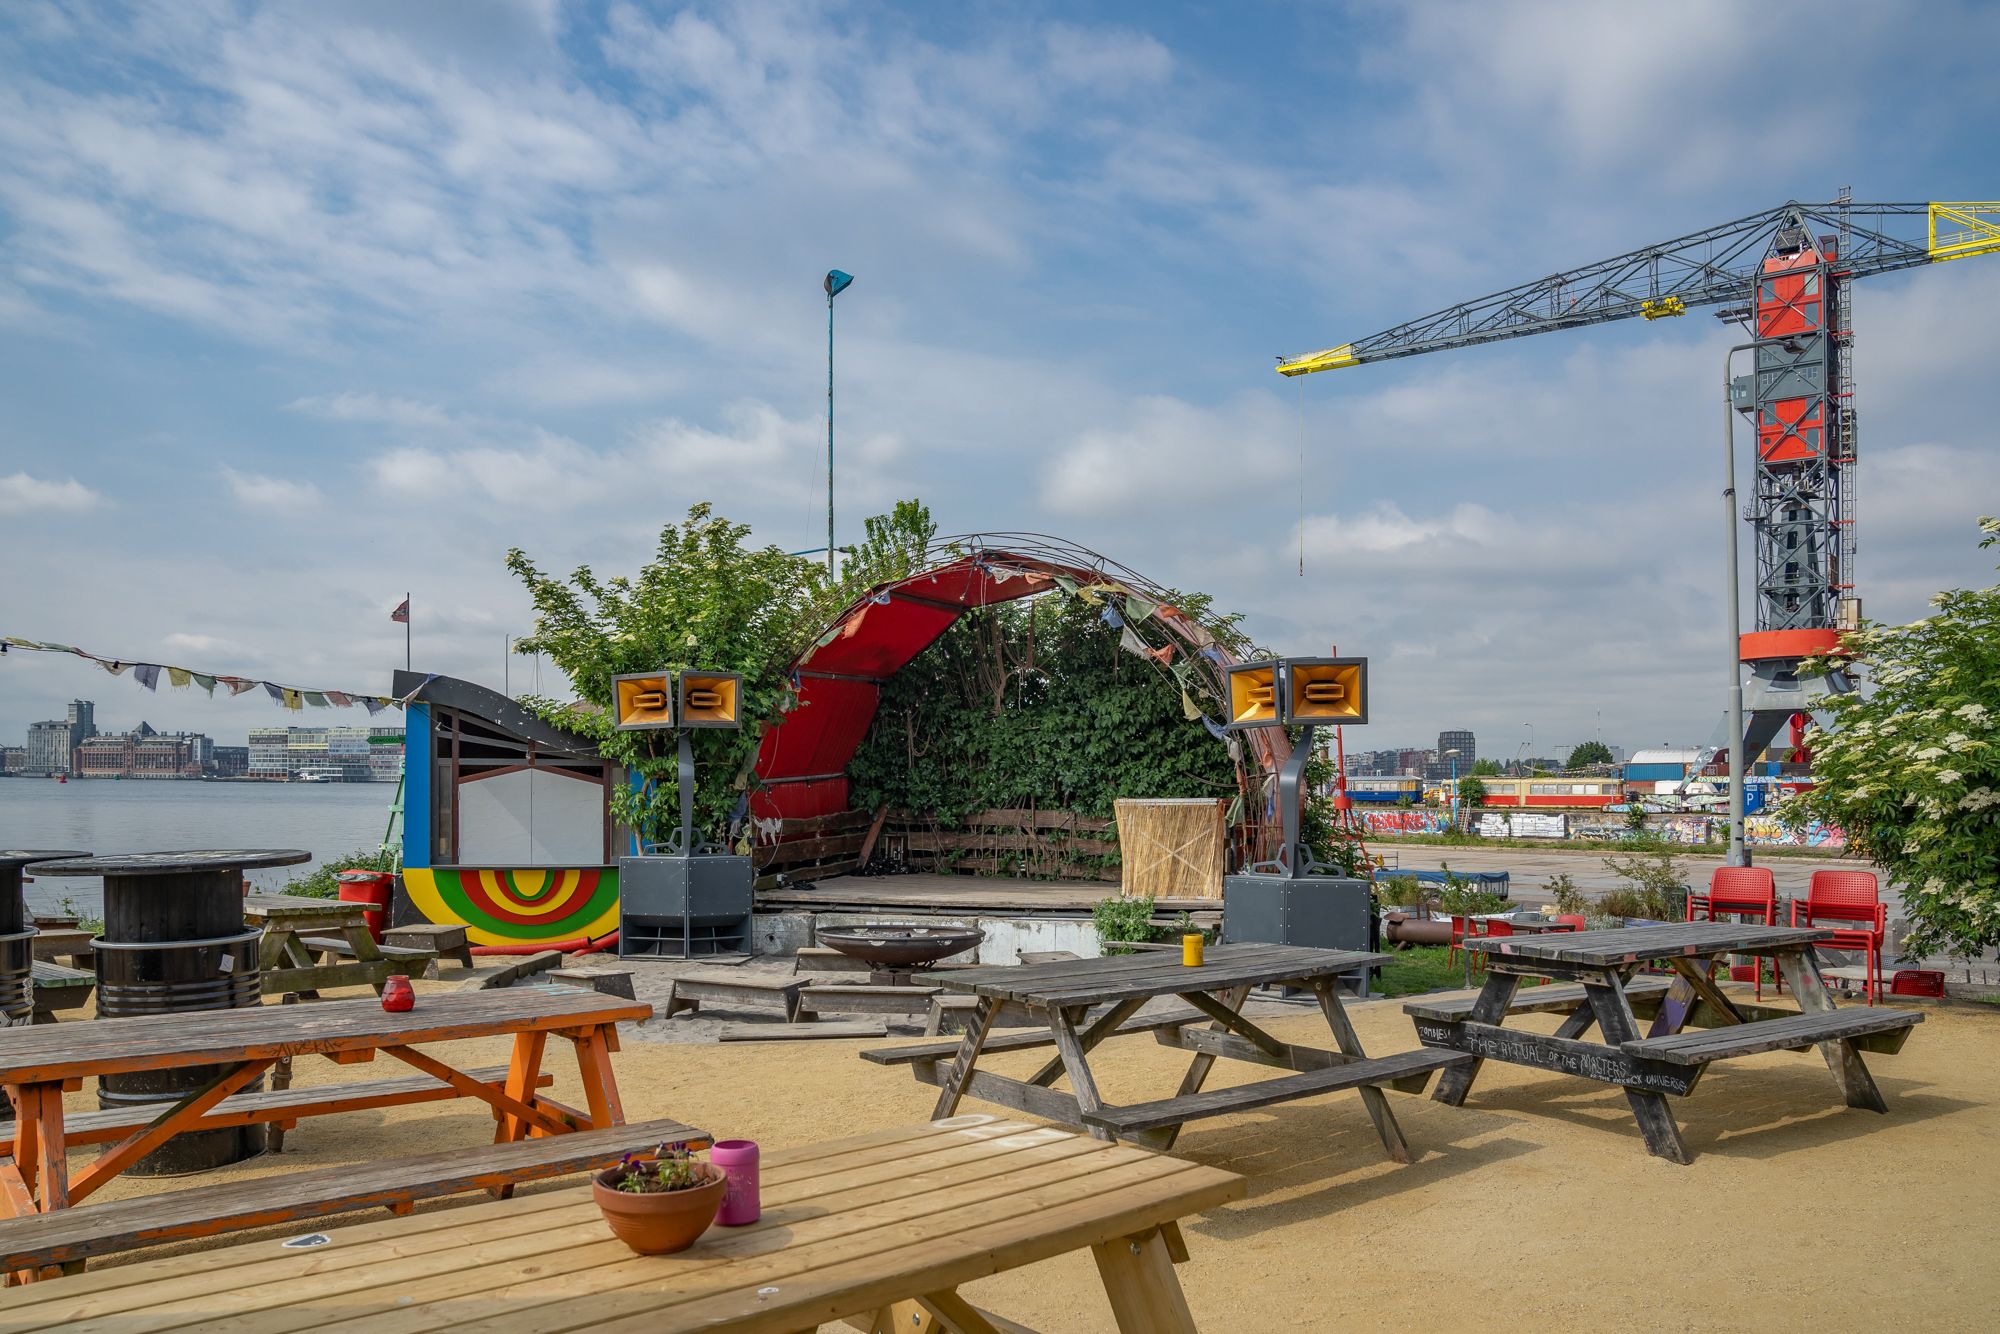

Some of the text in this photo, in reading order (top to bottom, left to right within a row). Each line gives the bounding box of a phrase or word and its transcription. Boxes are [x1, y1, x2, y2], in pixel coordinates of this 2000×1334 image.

[1747, 793, 1754, 806] P
[1467, 1036, 1497, 1054] THE
[1501, 1041, 1543, 1063] RITUAL
[1548, 1051, 1560, 1061] OF
[1561, 1054, 1577, 1069] THE
